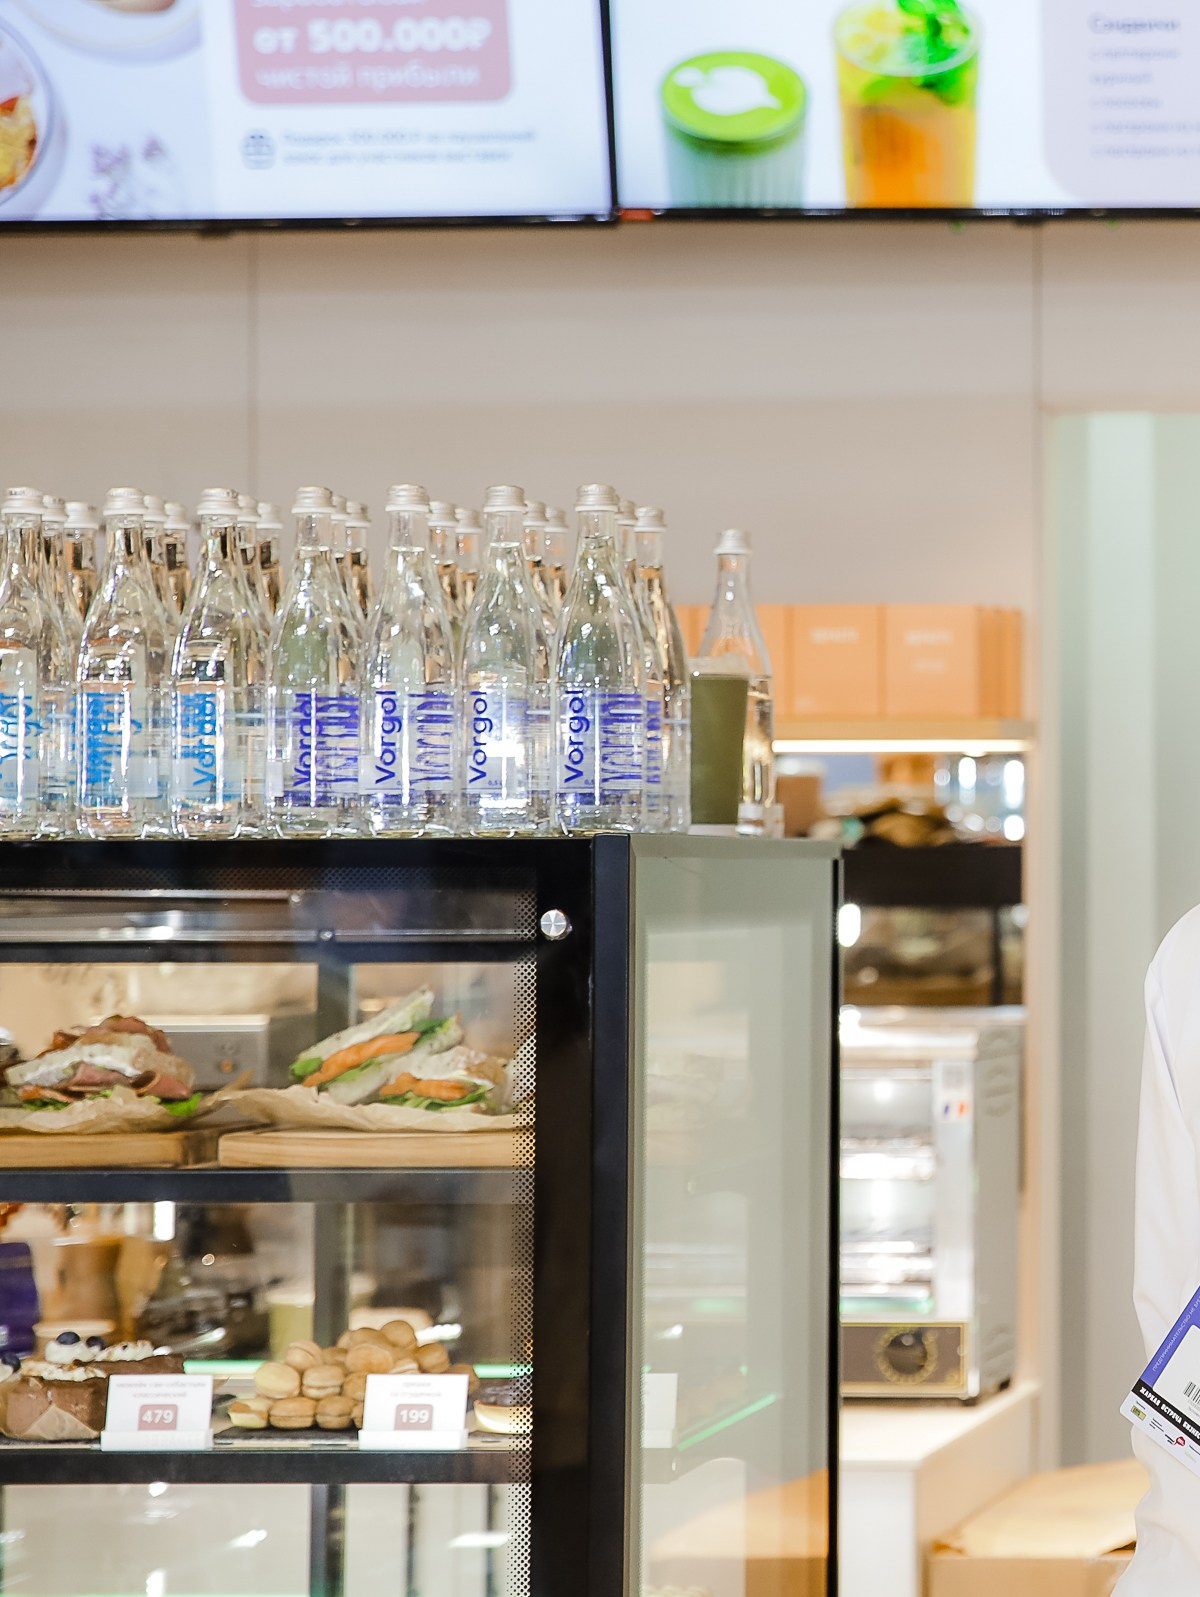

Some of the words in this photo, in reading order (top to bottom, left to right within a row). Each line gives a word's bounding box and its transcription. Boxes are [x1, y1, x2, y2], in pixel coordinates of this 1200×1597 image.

[252, 26, 298, 55] от
[375, 690, 403, 785] Vorgol
[468, 690, 494, 784] Vorgol
[563, 689, 591, 784] Vorgol
[141, 1409, 174, 1425] 479
[399, 1409, 430, 1425] 199
[1160, 1402, 1182, 1425] ВСТРЕЧА
